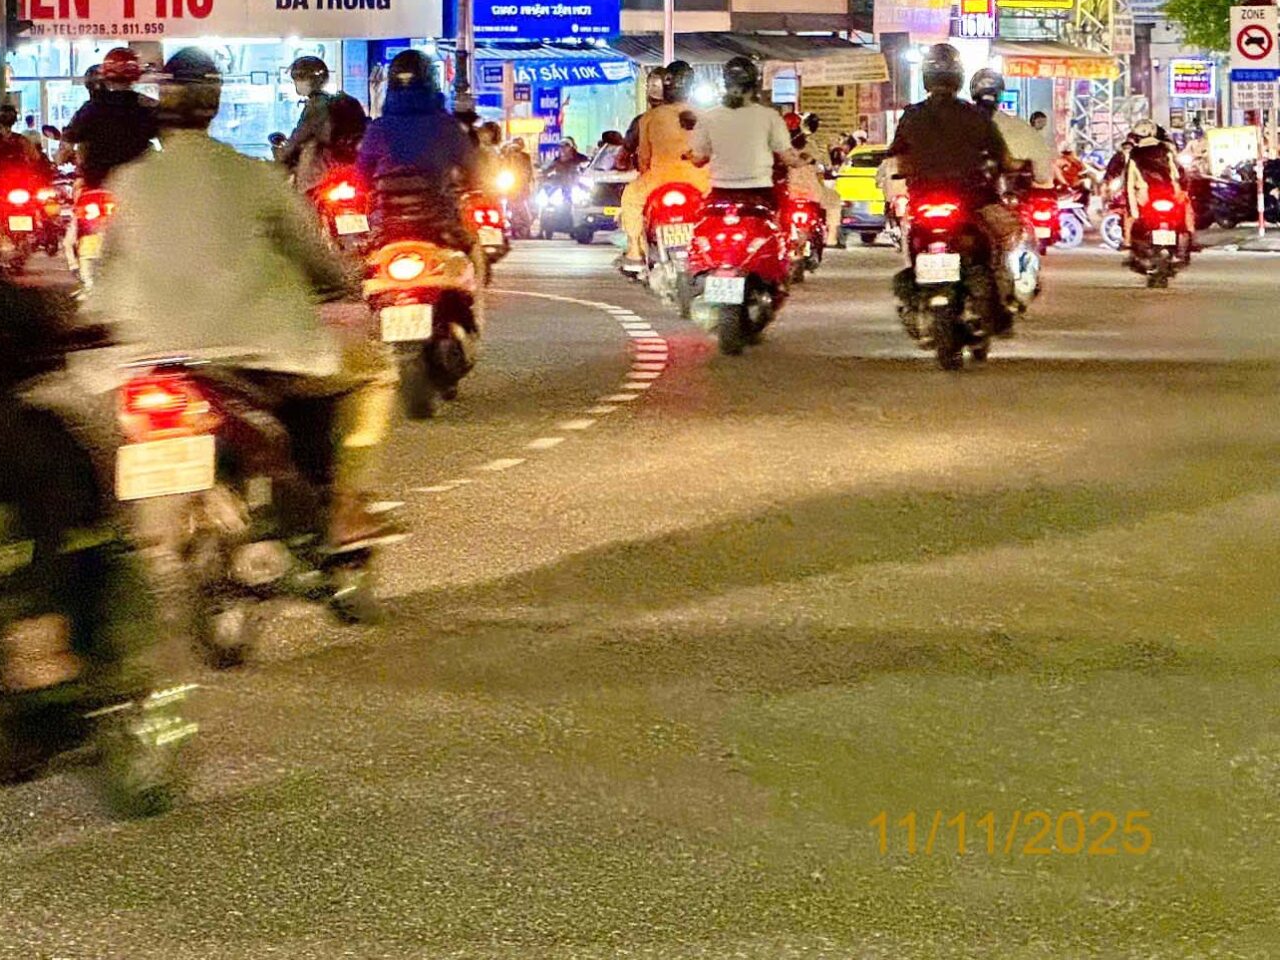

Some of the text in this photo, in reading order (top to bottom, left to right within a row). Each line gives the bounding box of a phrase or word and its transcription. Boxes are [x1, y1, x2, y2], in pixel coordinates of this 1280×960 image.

[1241, 8, 1265, 20] ZONE
[540, 63, 569, 81] SẤY
[572, 66, 600, 80] 10K
